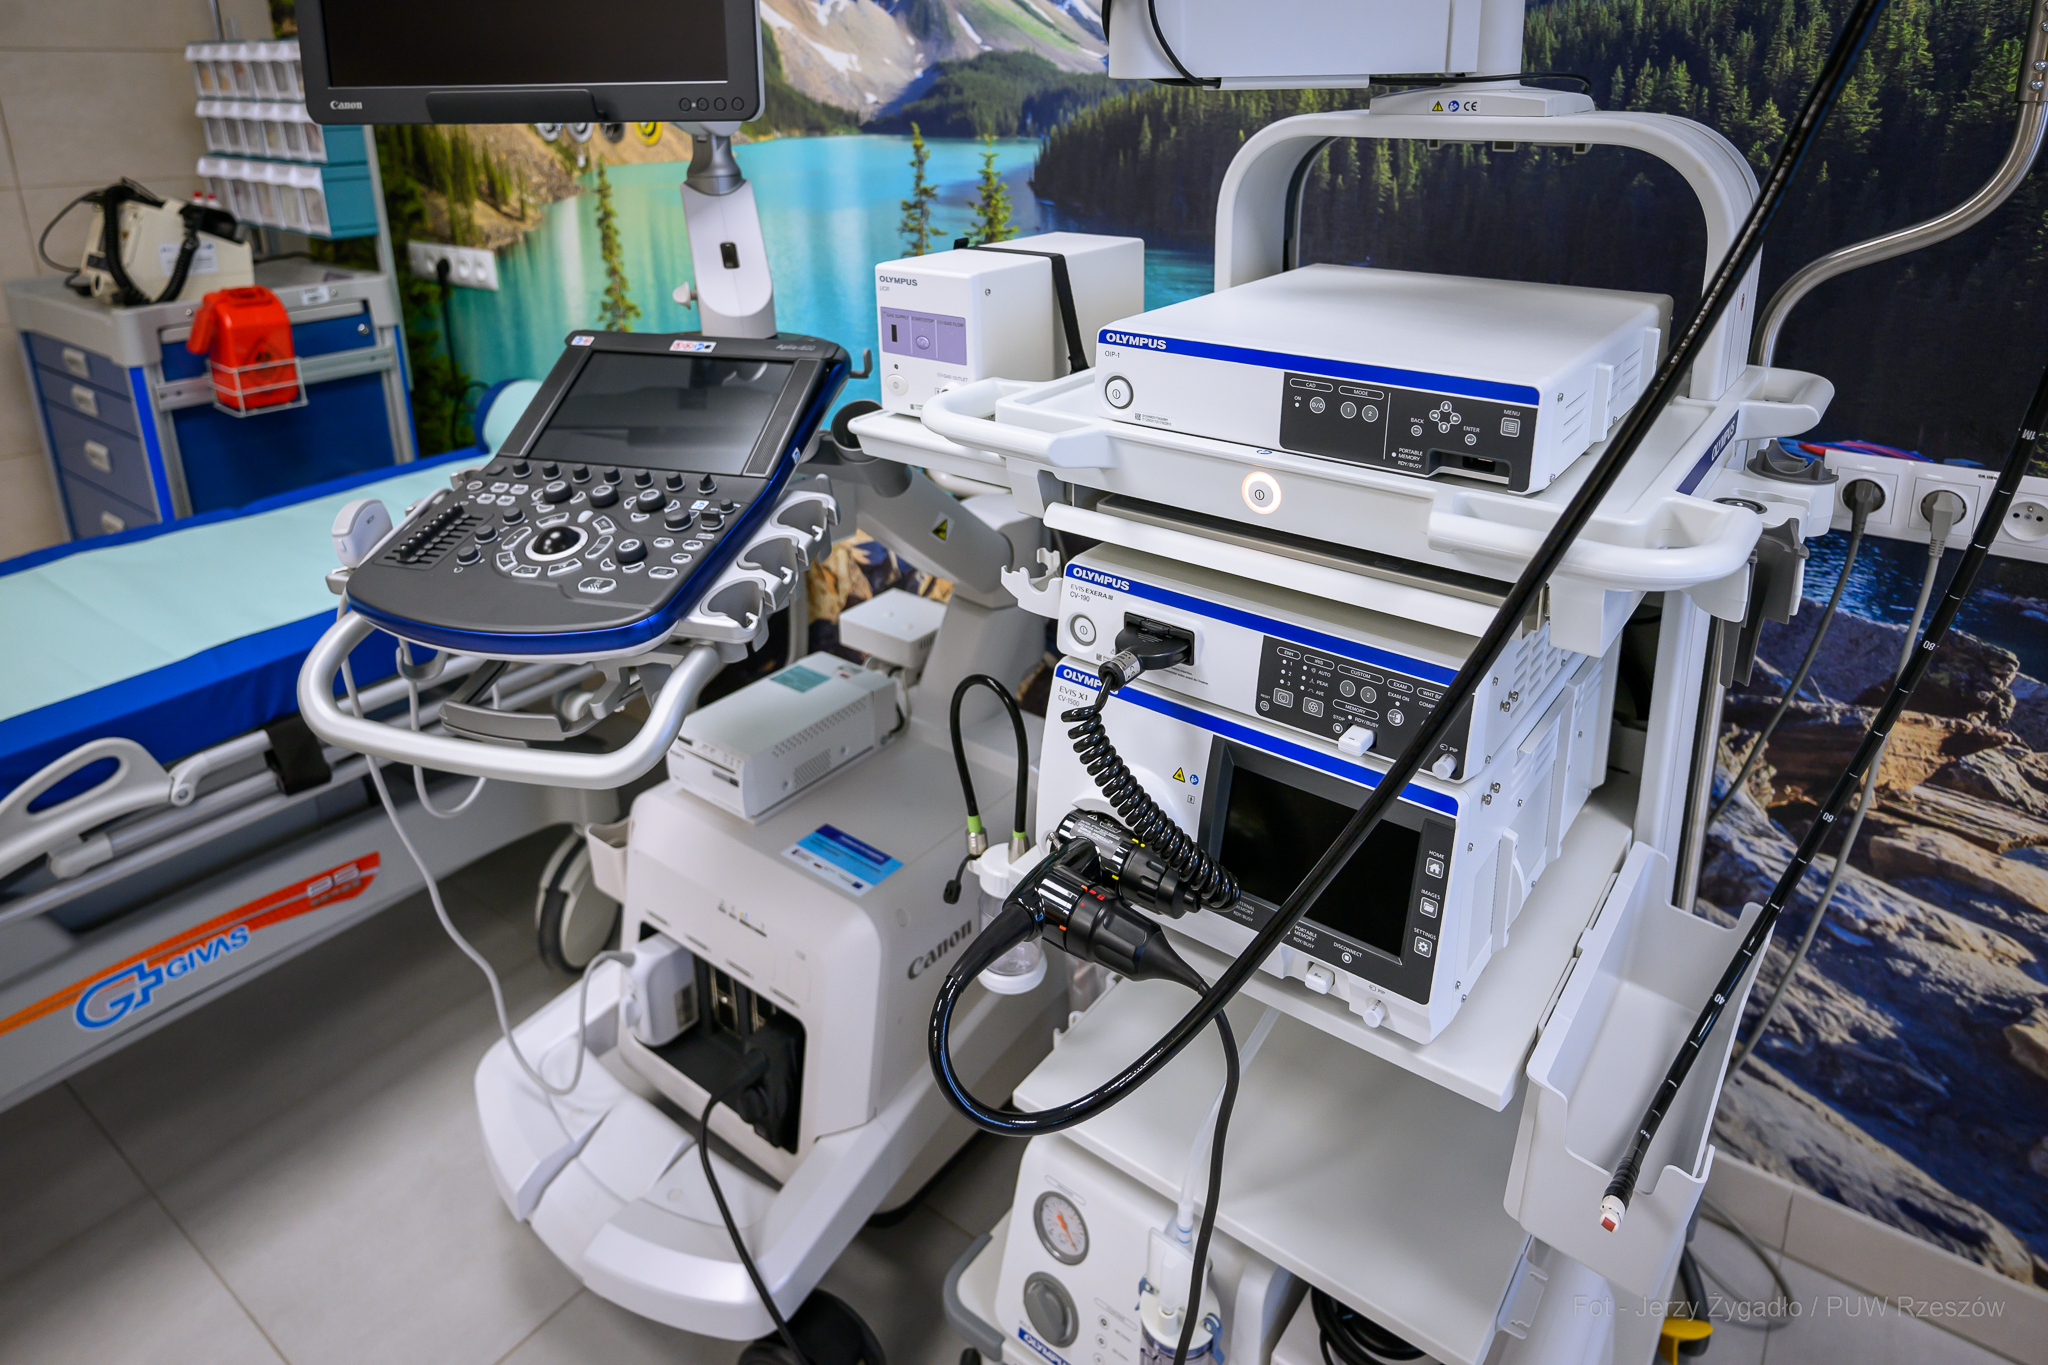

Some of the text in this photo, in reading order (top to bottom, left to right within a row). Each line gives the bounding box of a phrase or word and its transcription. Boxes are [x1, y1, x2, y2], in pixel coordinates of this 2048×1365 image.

[330, 100, 363, 110] Canon
[879, 275, 918, 286] OLYMPUS
[1105, 332, 1167, 350] OLYMPUS
[1104, 350, 1120, 359] OIP-1
[1463, 425, 1480, 433] ENTER
[1711, 420, 1736, 462] OLYMPUS
[1398, 453, 1421, 461] MEMORY
[1399, 447, 1423, 456] PORTABLE
[1398, 460, 1422, 468] RDY/BUSY
[1072, 567, 1130, 591] OLYMPUS
[1069, 590, 1090, 602] CV-190
[1070, 583, 1084, 592] EVIS
[1085, 588, 1107, 599] EXERA
[1350, 669, 1371, 679] CUSTOM
[1062, 668, 1119, 695] OLYMP
[1393, 682, 1408, 690] EXAM
[1059, 685, 1077, 697] EVIS
[1387, 691, 1402, 700] EXAM
[1057, 694, 1080, 707] CV-1500
[1345, 704, 1366, 714] MEMORY
[1428, 850, 1445, 860] HOME
[1421, 888, 1440, 900] IMAGES
[1238, 900, 1255, 911] TERNAL
[1294, 925, 1318, 938] PORTABLE
[1294, 930, 1315, 942] MEMORY
[1413, 927, 1437, 940] SETTINGS
[166, 925, 250, 979] GIVAS
[907, 919, 973, 980] Canon
[1333, 941, 1363, 958] DISCONNECT
